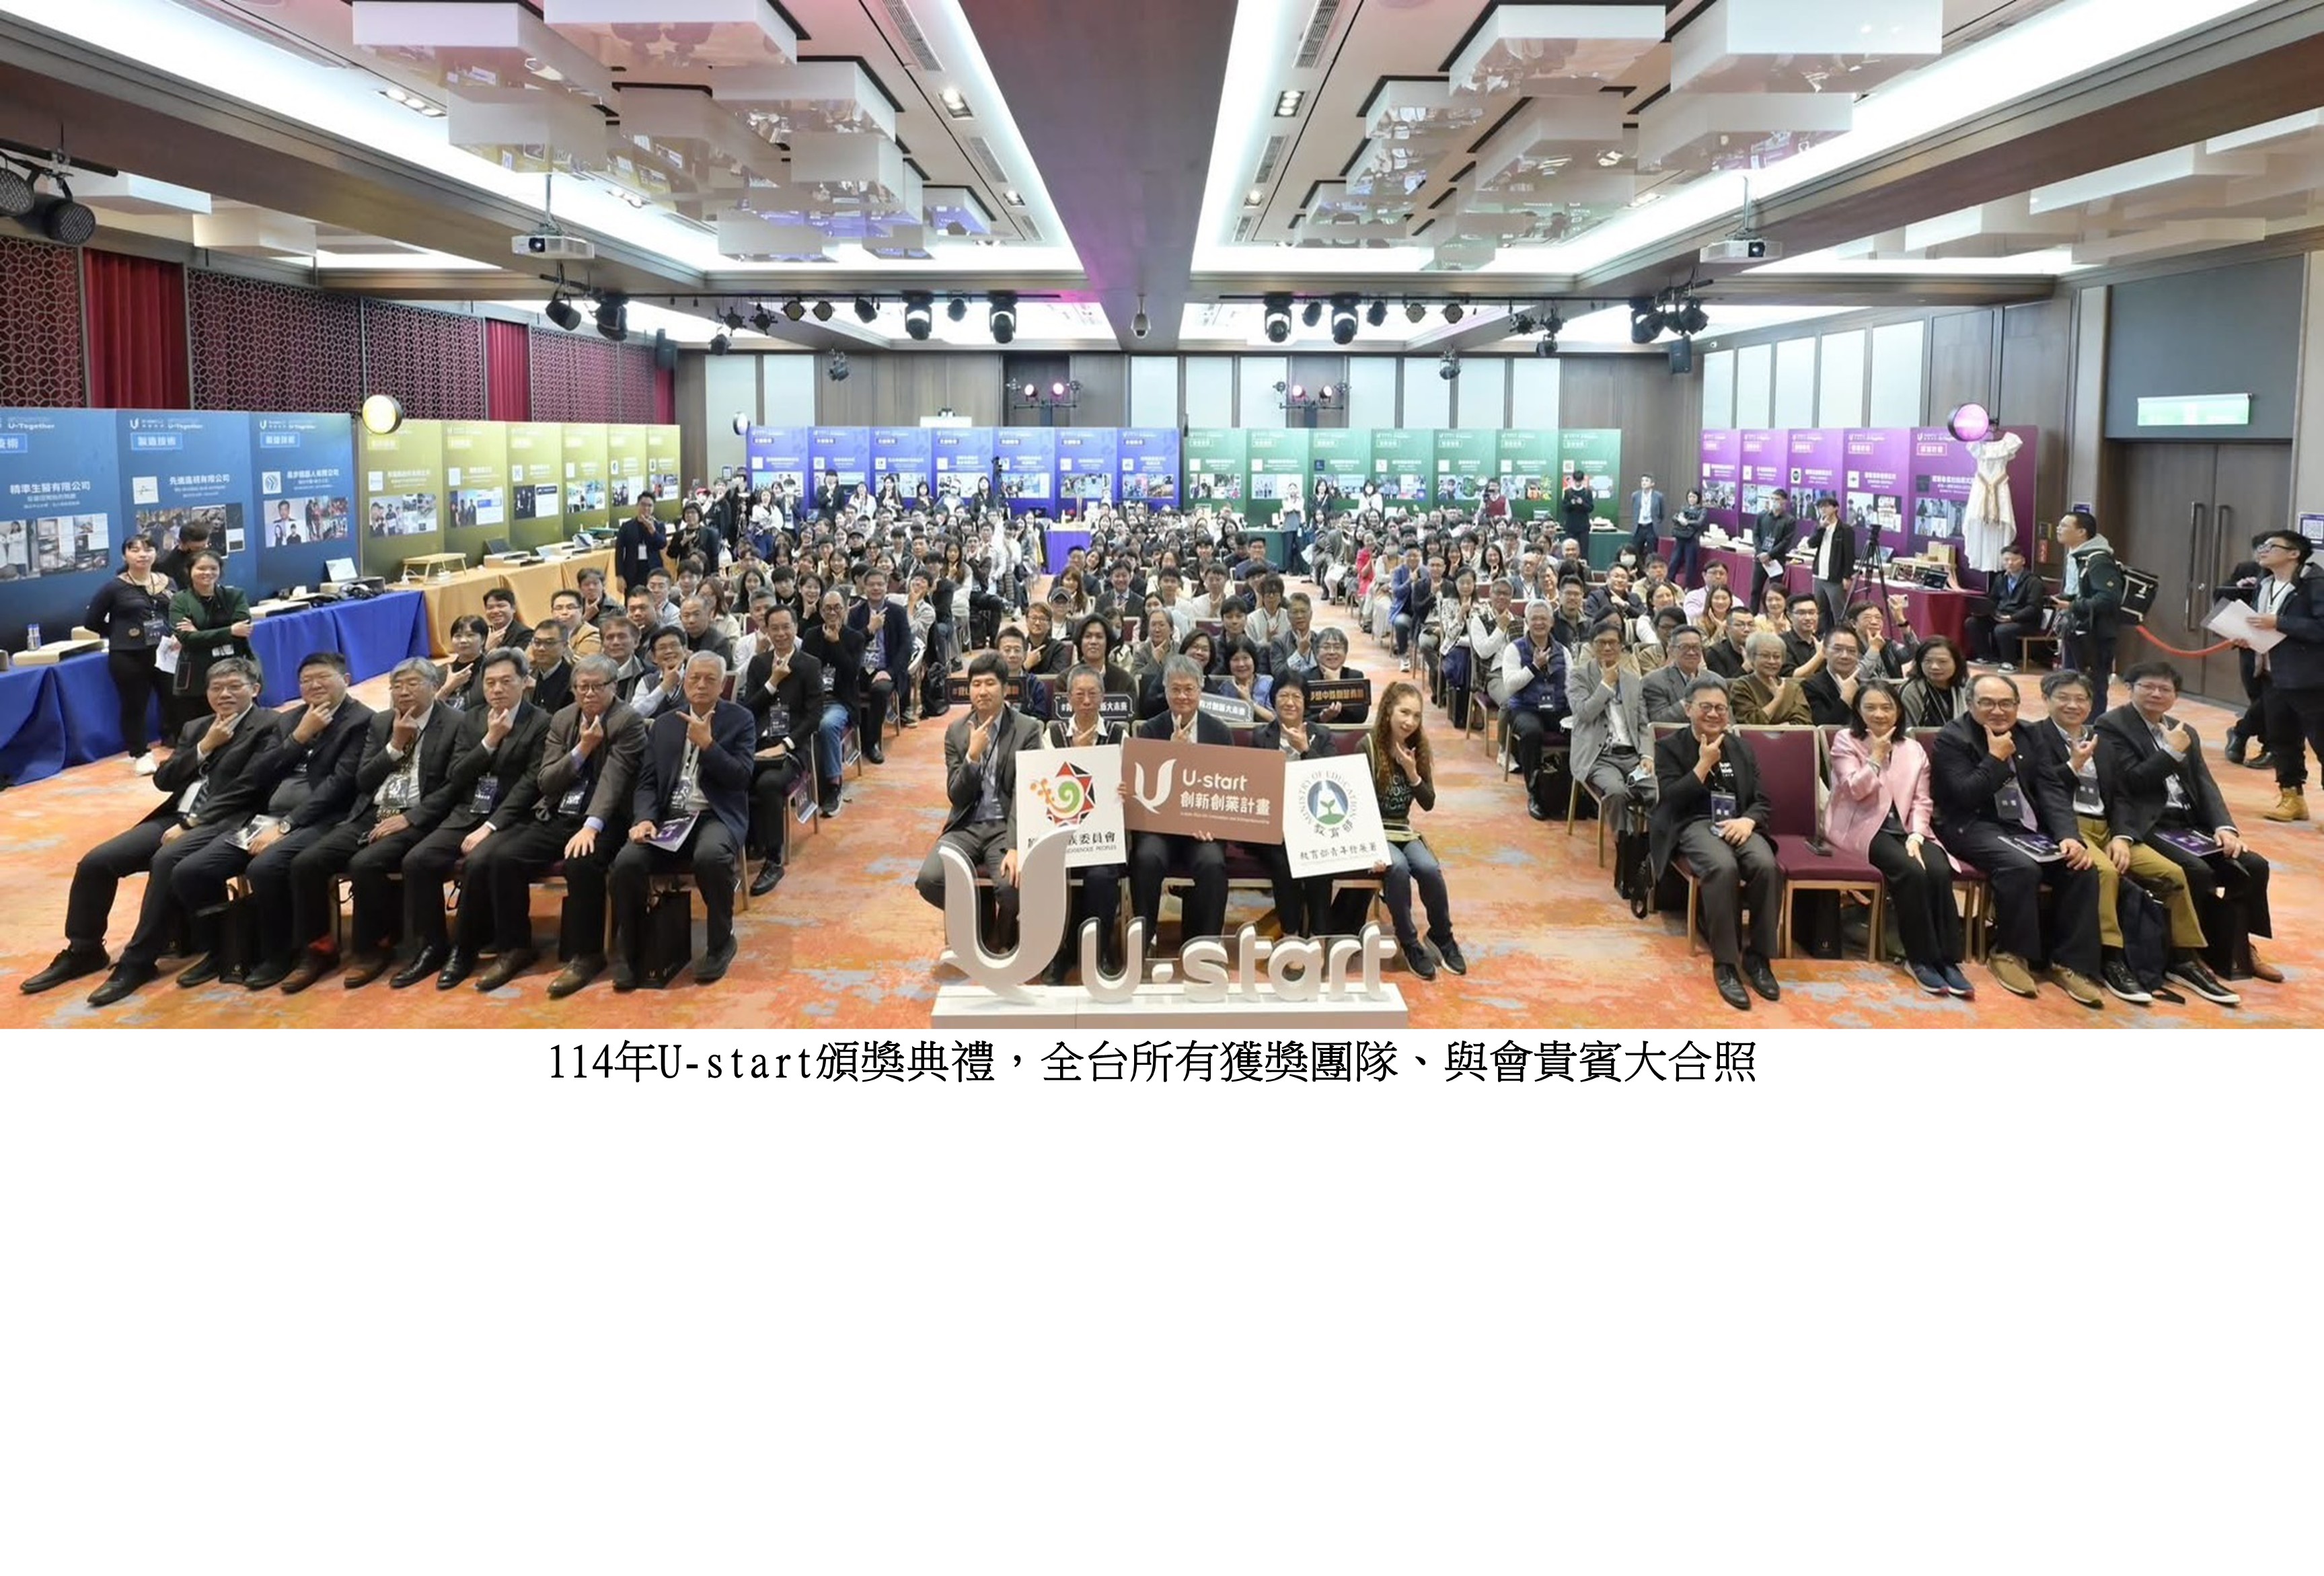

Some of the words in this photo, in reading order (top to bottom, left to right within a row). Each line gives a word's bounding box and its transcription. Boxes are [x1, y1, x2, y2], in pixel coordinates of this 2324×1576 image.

[1183, 768, 1248, 791] U-start
[1180, 791, 1270, 816] 創新創業計畫
